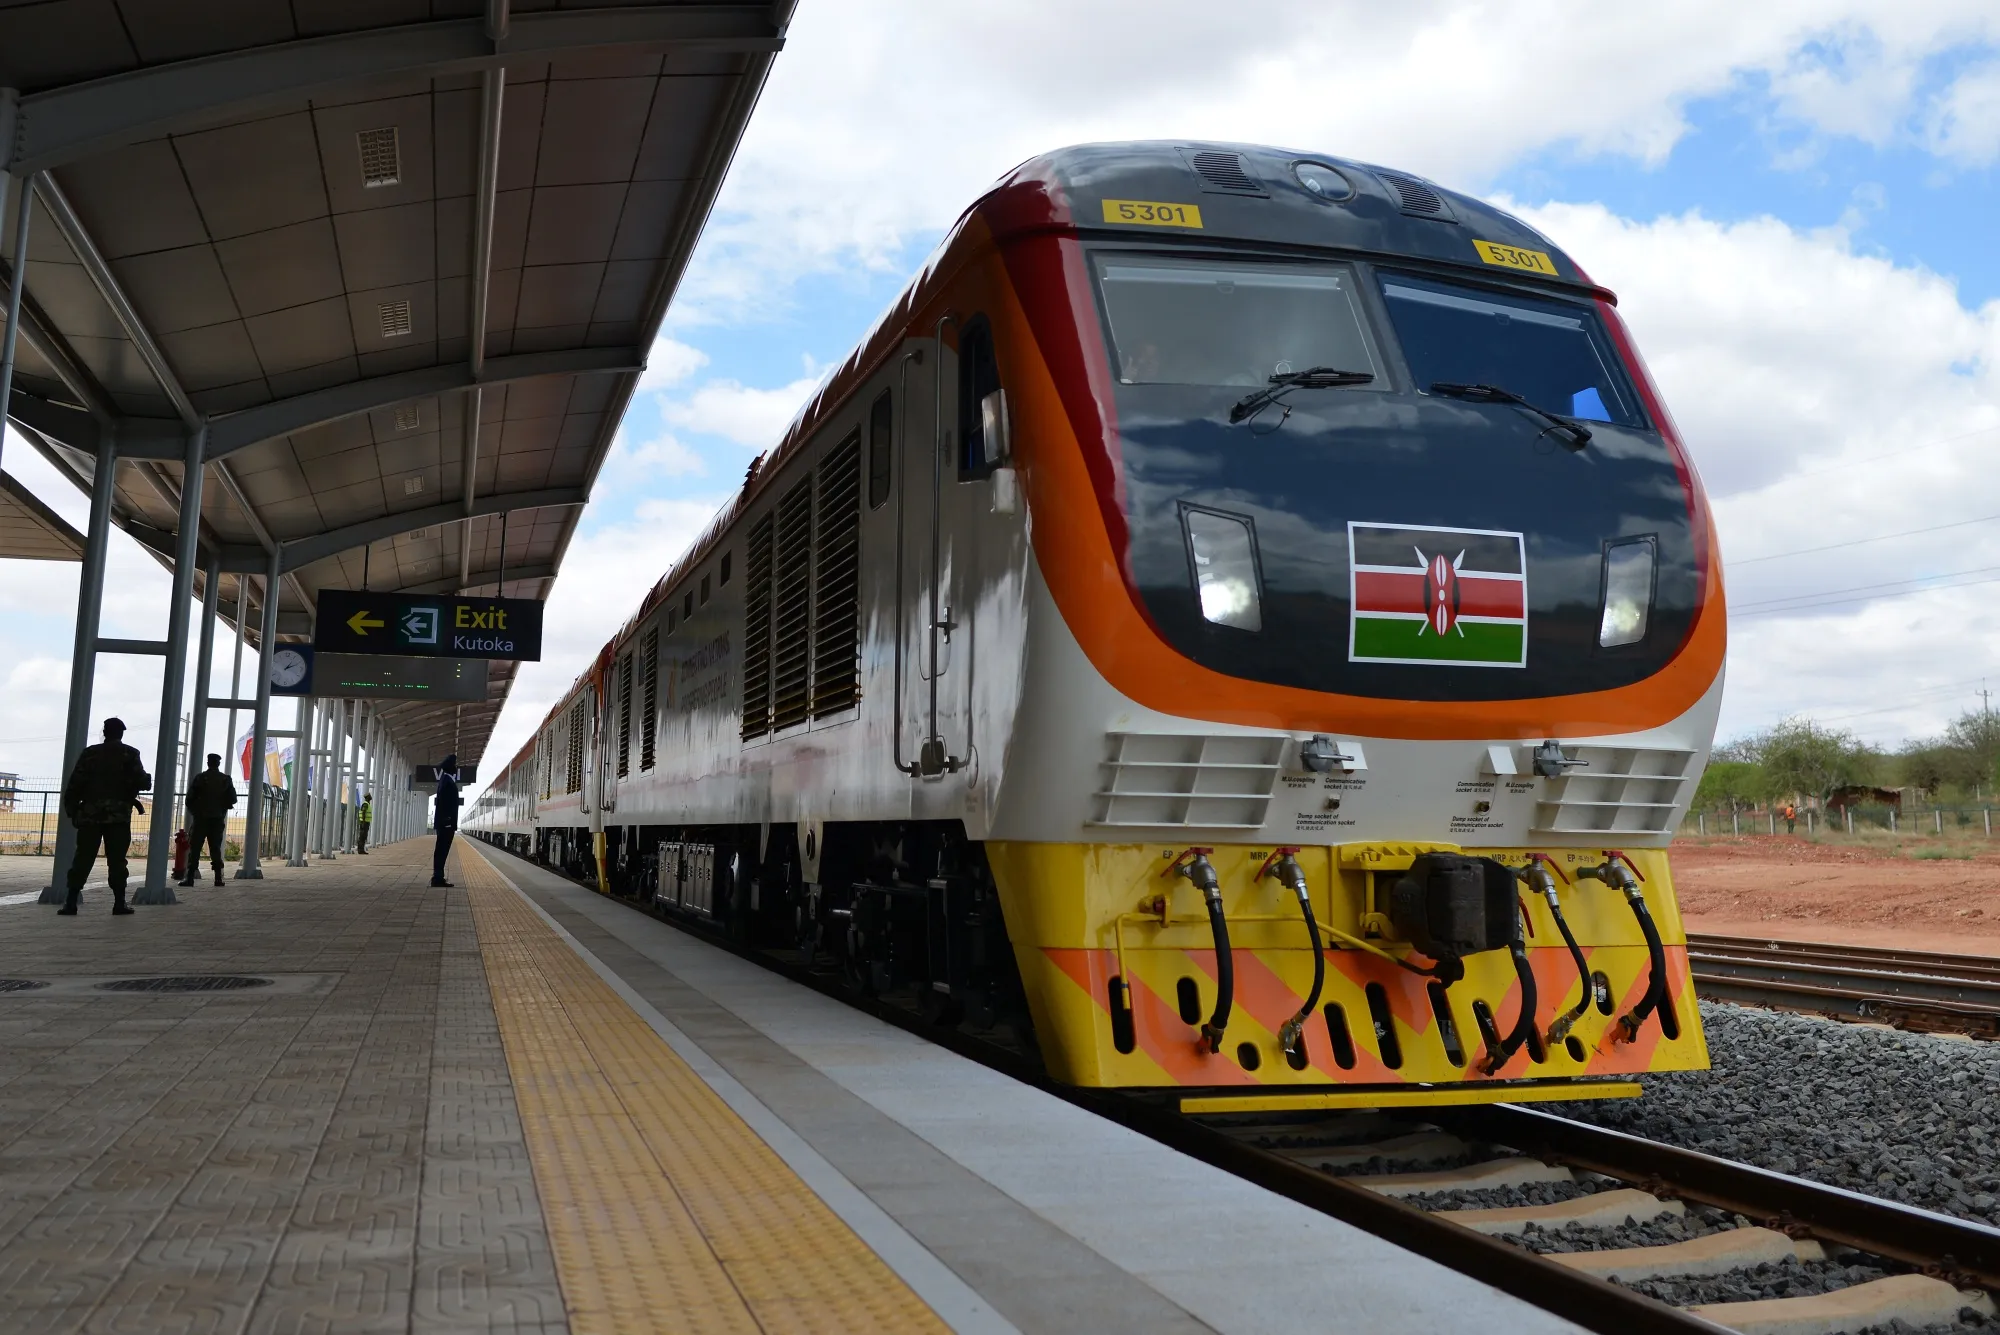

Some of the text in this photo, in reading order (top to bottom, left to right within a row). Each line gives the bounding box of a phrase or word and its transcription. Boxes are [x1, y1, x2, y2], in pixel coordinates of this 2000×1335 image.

[1118, 203, 1186, 224] 5301
[1487, 245, 1545, 271] 5301
[455, 605, 508, 630] Exit
[453, 635, 514, 652] Kutoka
[1325, 777, 1366, 785] Communication
[1162, 850, 1173, 859] EP
[1250, 852, 1268, 860] MRP
[1491, 854, 1506, 862] MRP
[1567, 854, 1576, 862] EP
